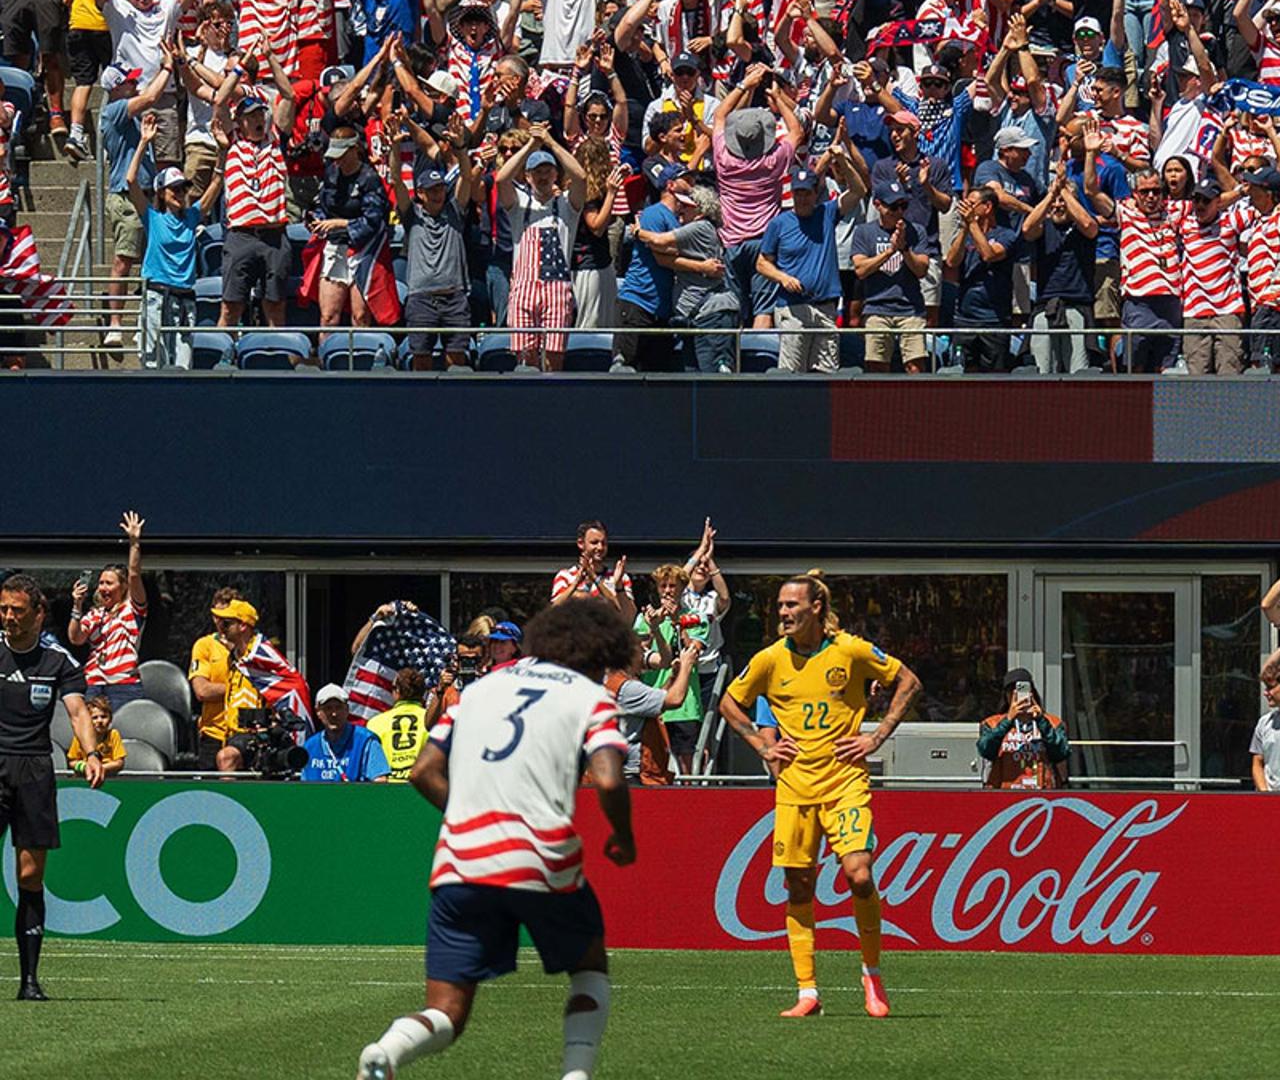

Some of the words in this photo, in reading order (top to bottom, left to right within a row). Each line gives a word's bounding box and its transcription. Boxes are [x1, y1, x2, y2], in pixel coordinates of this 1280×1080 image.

[32, 686, 50, 695] FIFA
[482, 688, 547, 762] 3
[803, 702, 831, 730] 22
[838, 808, 863, 837] 22
